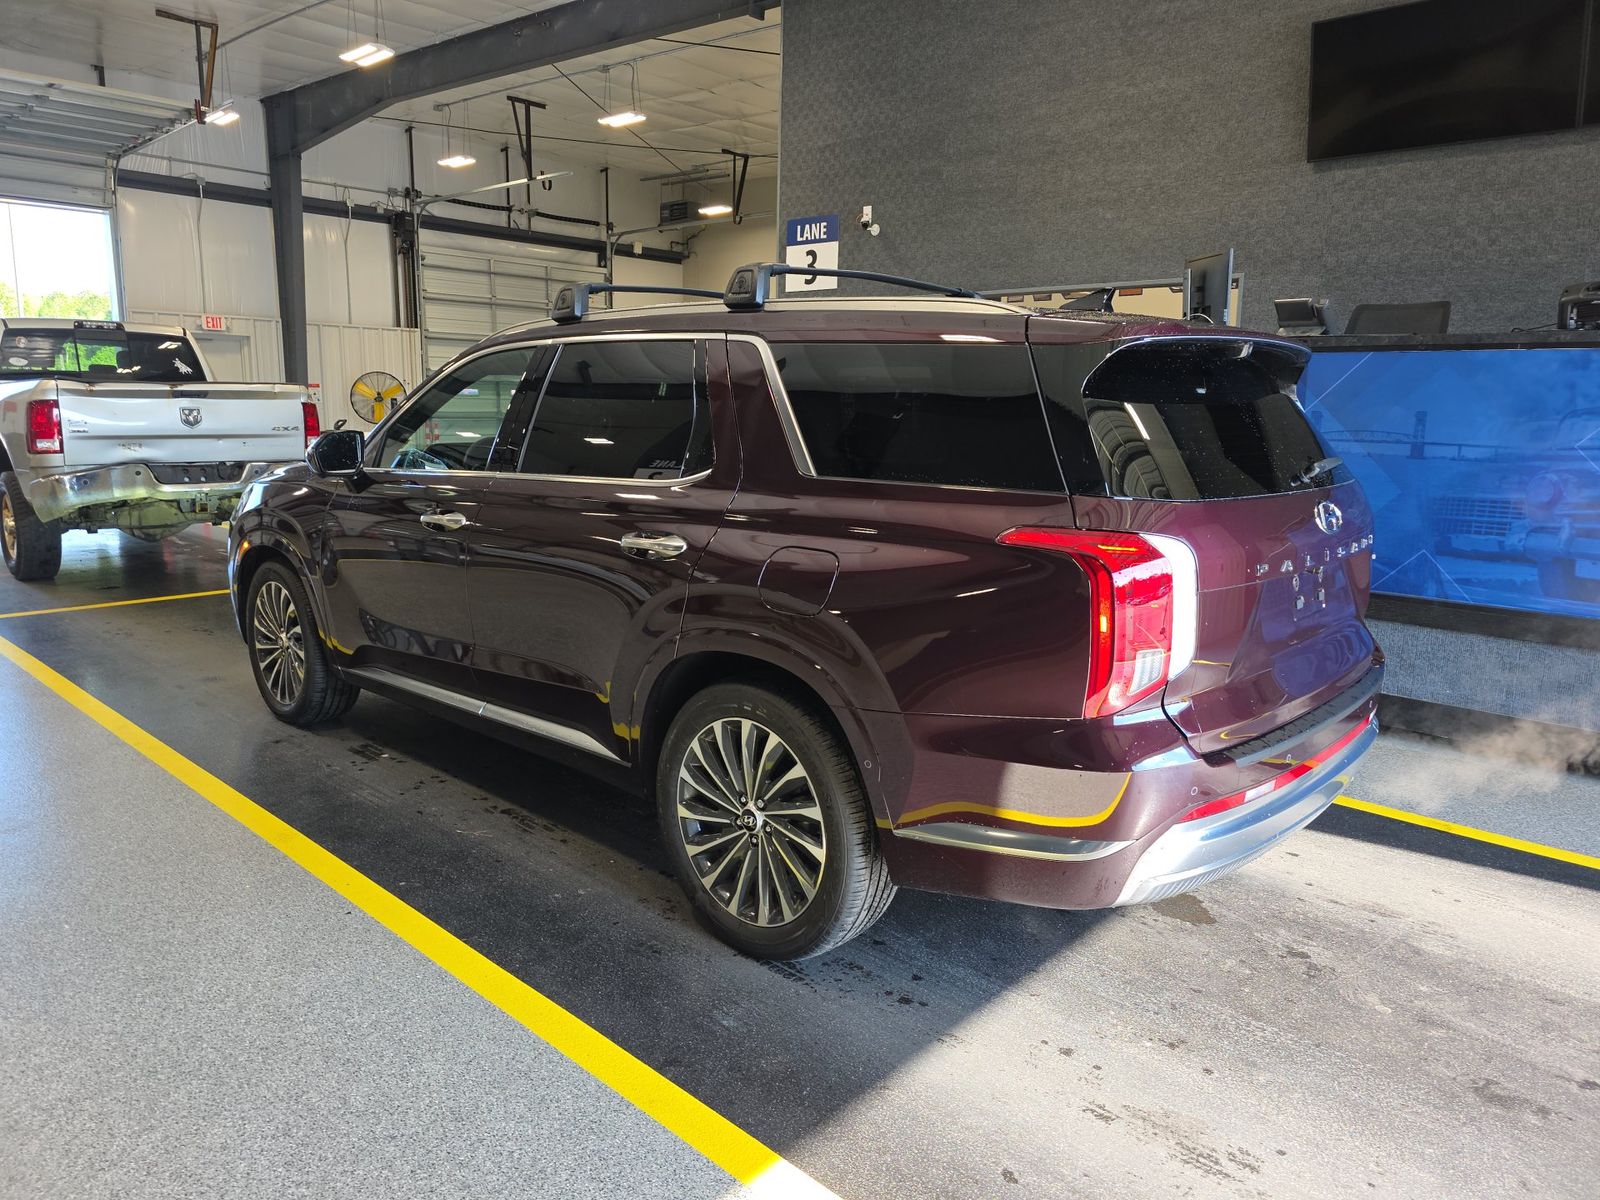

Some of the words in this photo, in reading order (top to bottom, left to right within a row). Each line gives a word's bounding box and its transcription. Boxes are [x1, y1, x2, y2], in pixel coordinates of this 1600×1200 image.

[796, 222, 828, 242] LANE
[804, 249, 818, 285] 3
[205, 316, 223, 329] EXIT
